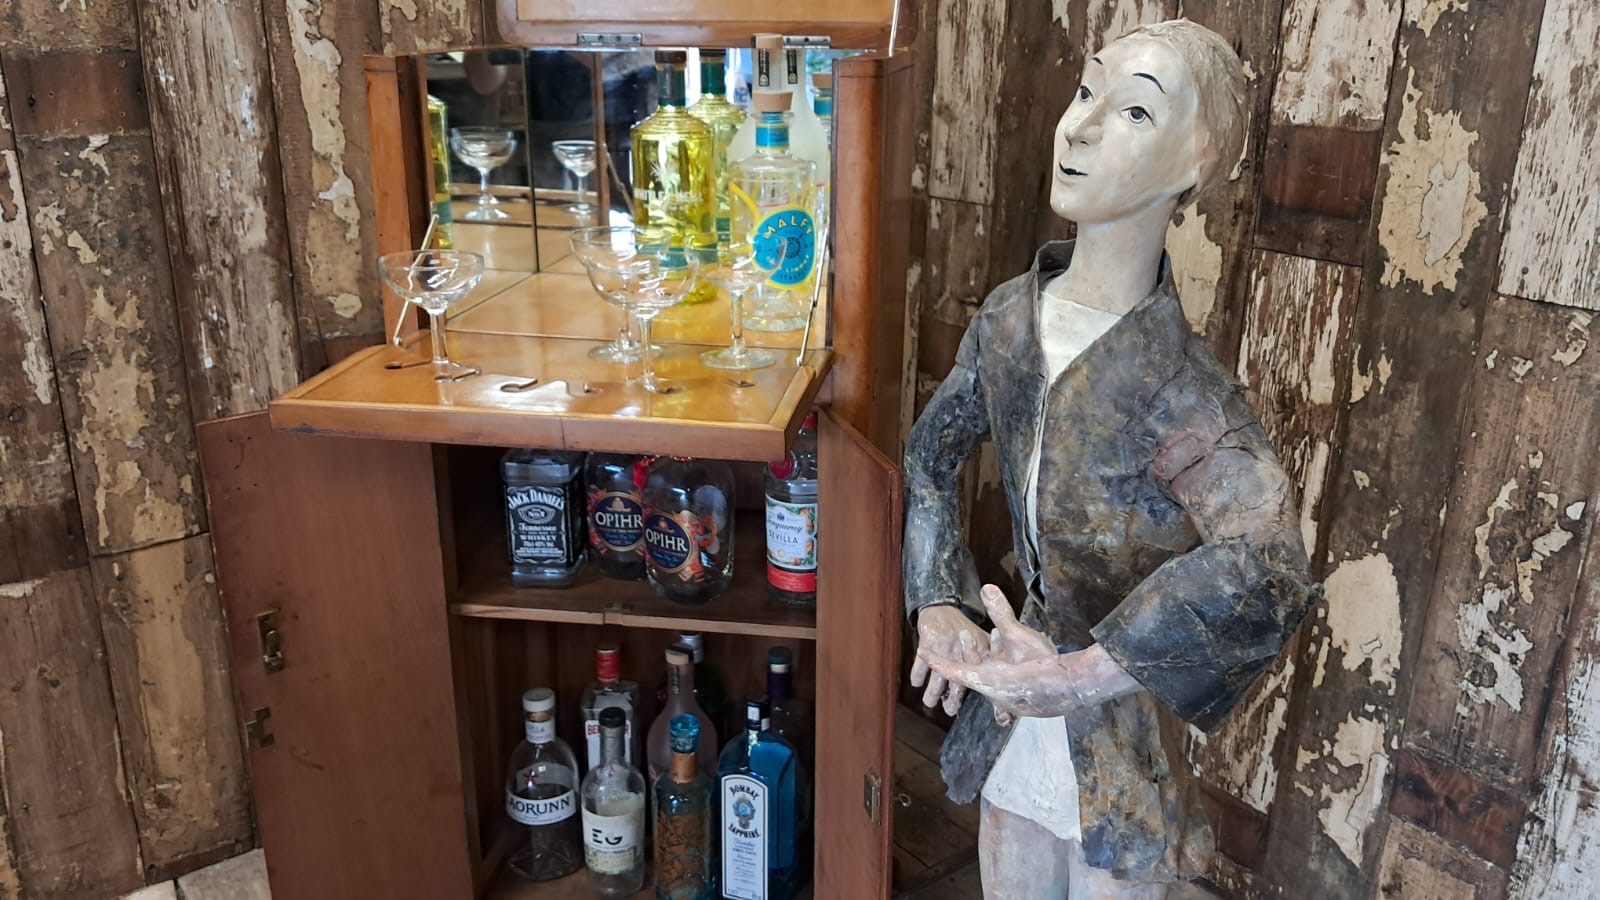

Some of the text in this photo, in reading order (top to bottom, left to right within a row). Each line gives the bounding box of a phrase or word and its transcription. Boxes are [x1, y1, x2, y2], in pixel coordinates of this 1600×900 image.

[763, 214, 813, 240] MALFY
[507, 492, 530, 510] JACK
[595, 511, 643, 529] OPIHR
[645, 527, 688, 552] OPIHR
[769, 529, 799, 544] SEVILLA
[729, 784, 759, 801] BOMBAY
[728, 823, 761, 839] SAPPHIRE
